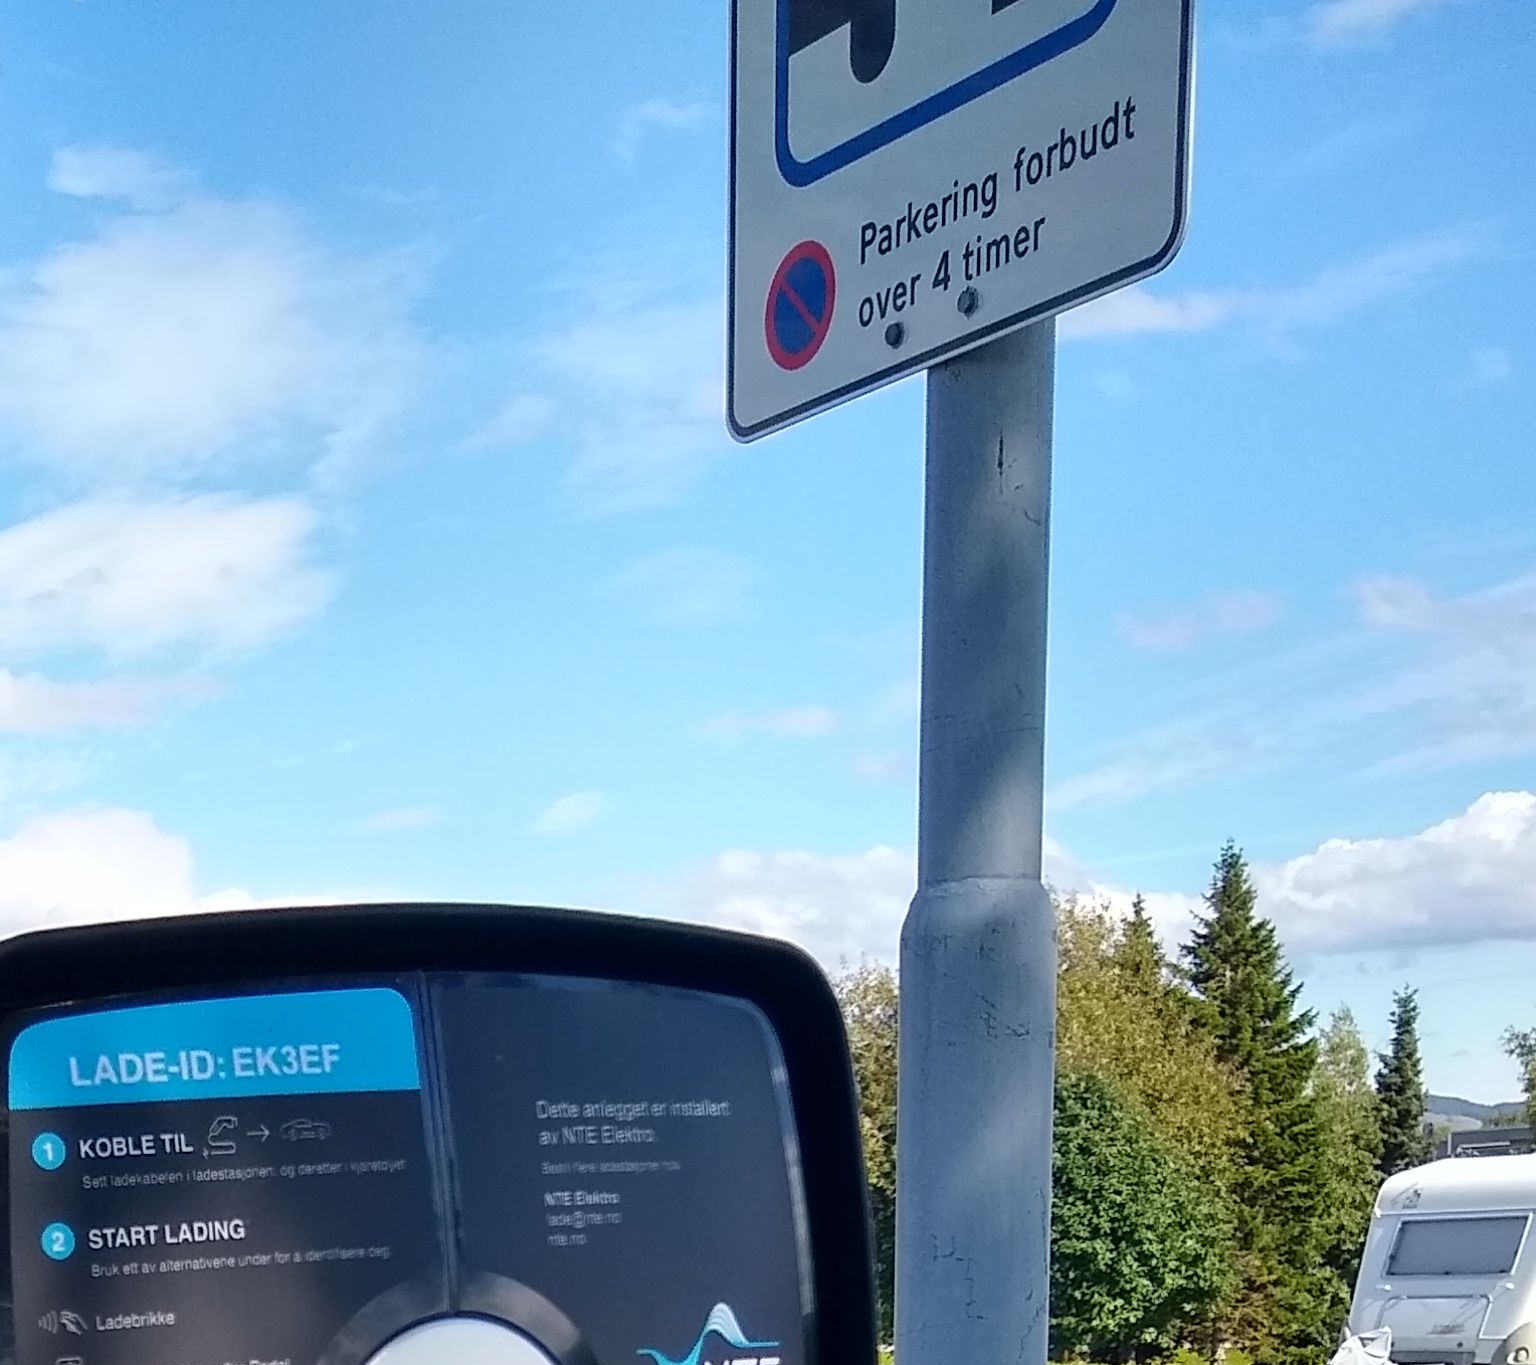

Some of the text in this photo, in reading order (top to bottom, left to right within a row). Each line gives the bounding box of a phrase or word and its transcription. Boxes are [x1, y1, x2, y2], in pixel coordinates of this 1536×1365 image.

[860, 96, 1136, 265] Parkering forbudt
[858, 217, 1048, 328] over 4 timer
[69, 1044, 340, 1087] LADE-ID: EK3EF
[79, 1133, 194, 1159] KOBLE TIL
[87, 1219, 246, 1250] START LADING
[96, 1310, 176, 1331] Ladebrikke
